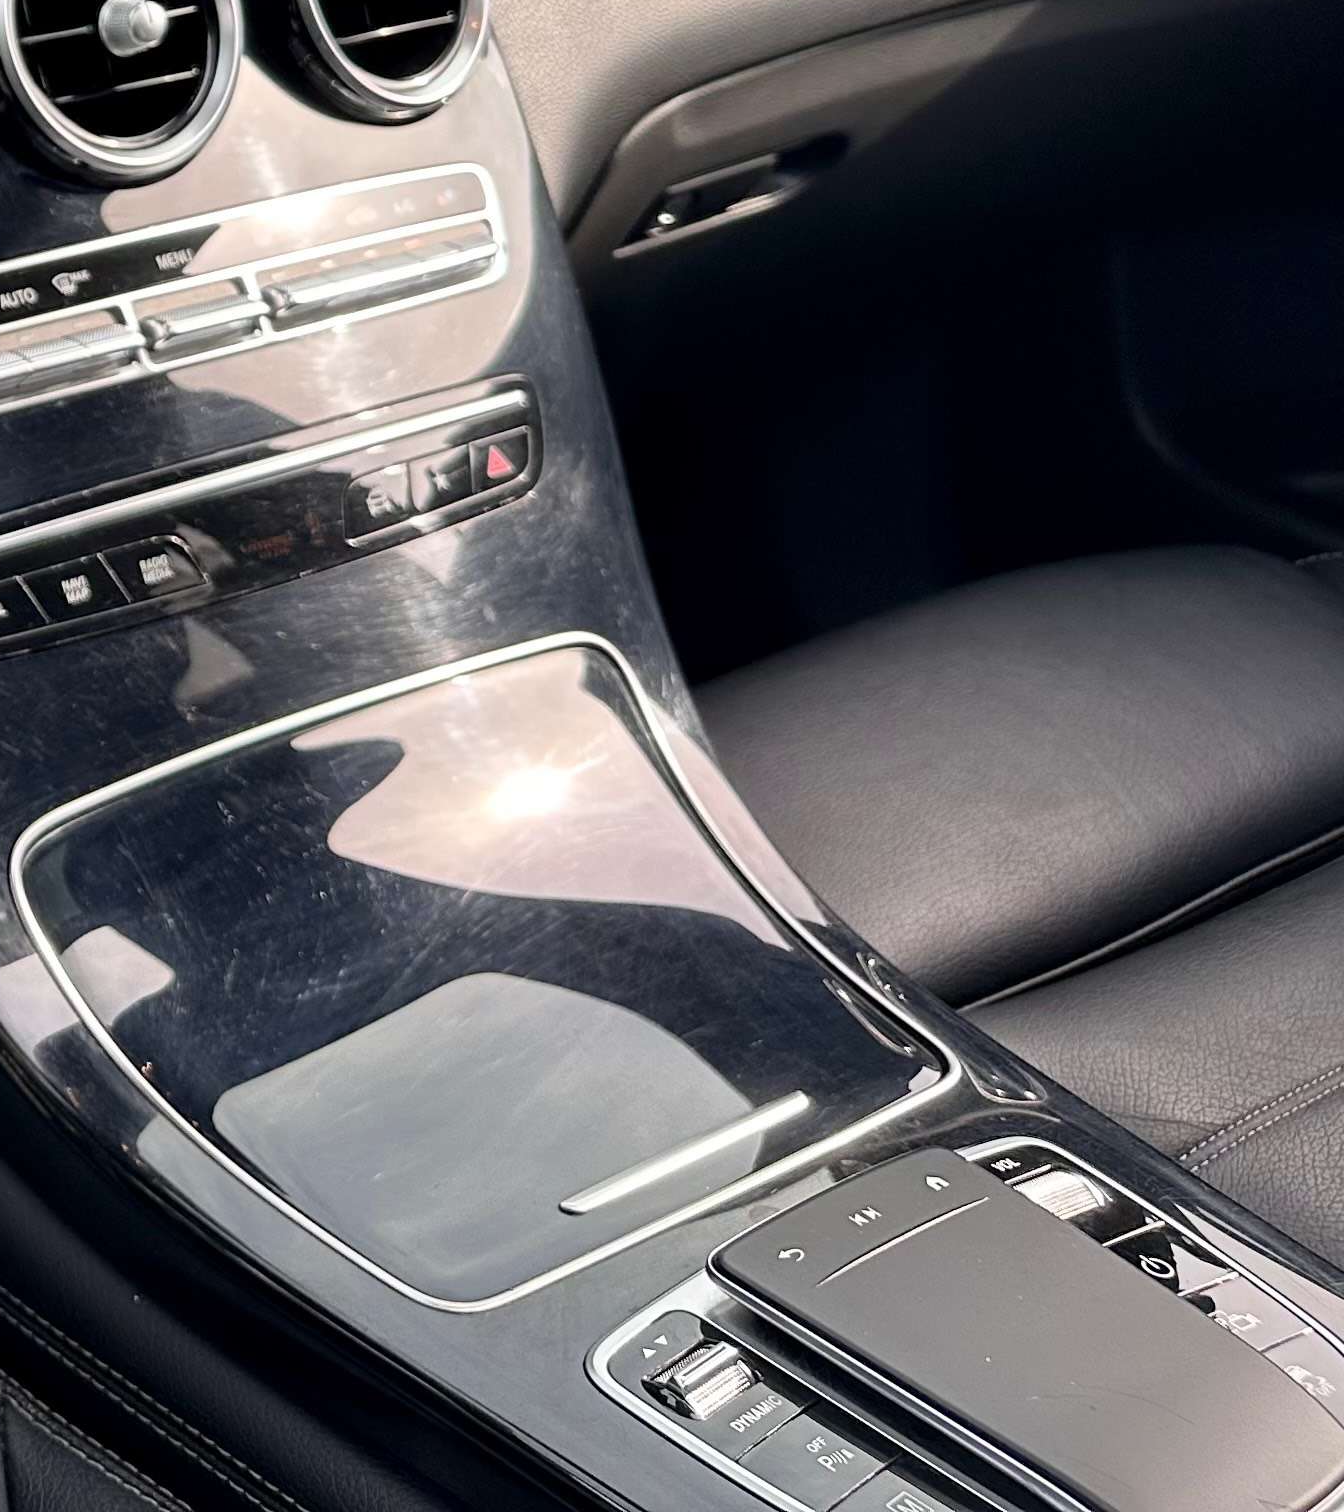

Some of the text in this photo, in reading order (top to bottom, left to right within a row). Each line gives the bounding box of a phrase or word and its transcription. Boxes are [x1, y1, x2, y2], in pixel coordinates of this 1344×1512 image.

[155, 248, 195, 272] MENU
[0, 286, 39, 311] AUTO
[139, 554, 169, 571] RADIO
[62, 575, 88, 592] NAVI
[143, 568, 176, 585] MEDIA
[729, 1394, 783, 1433] DYNAMIC
[806, 1436, 828, 1454] OFF
